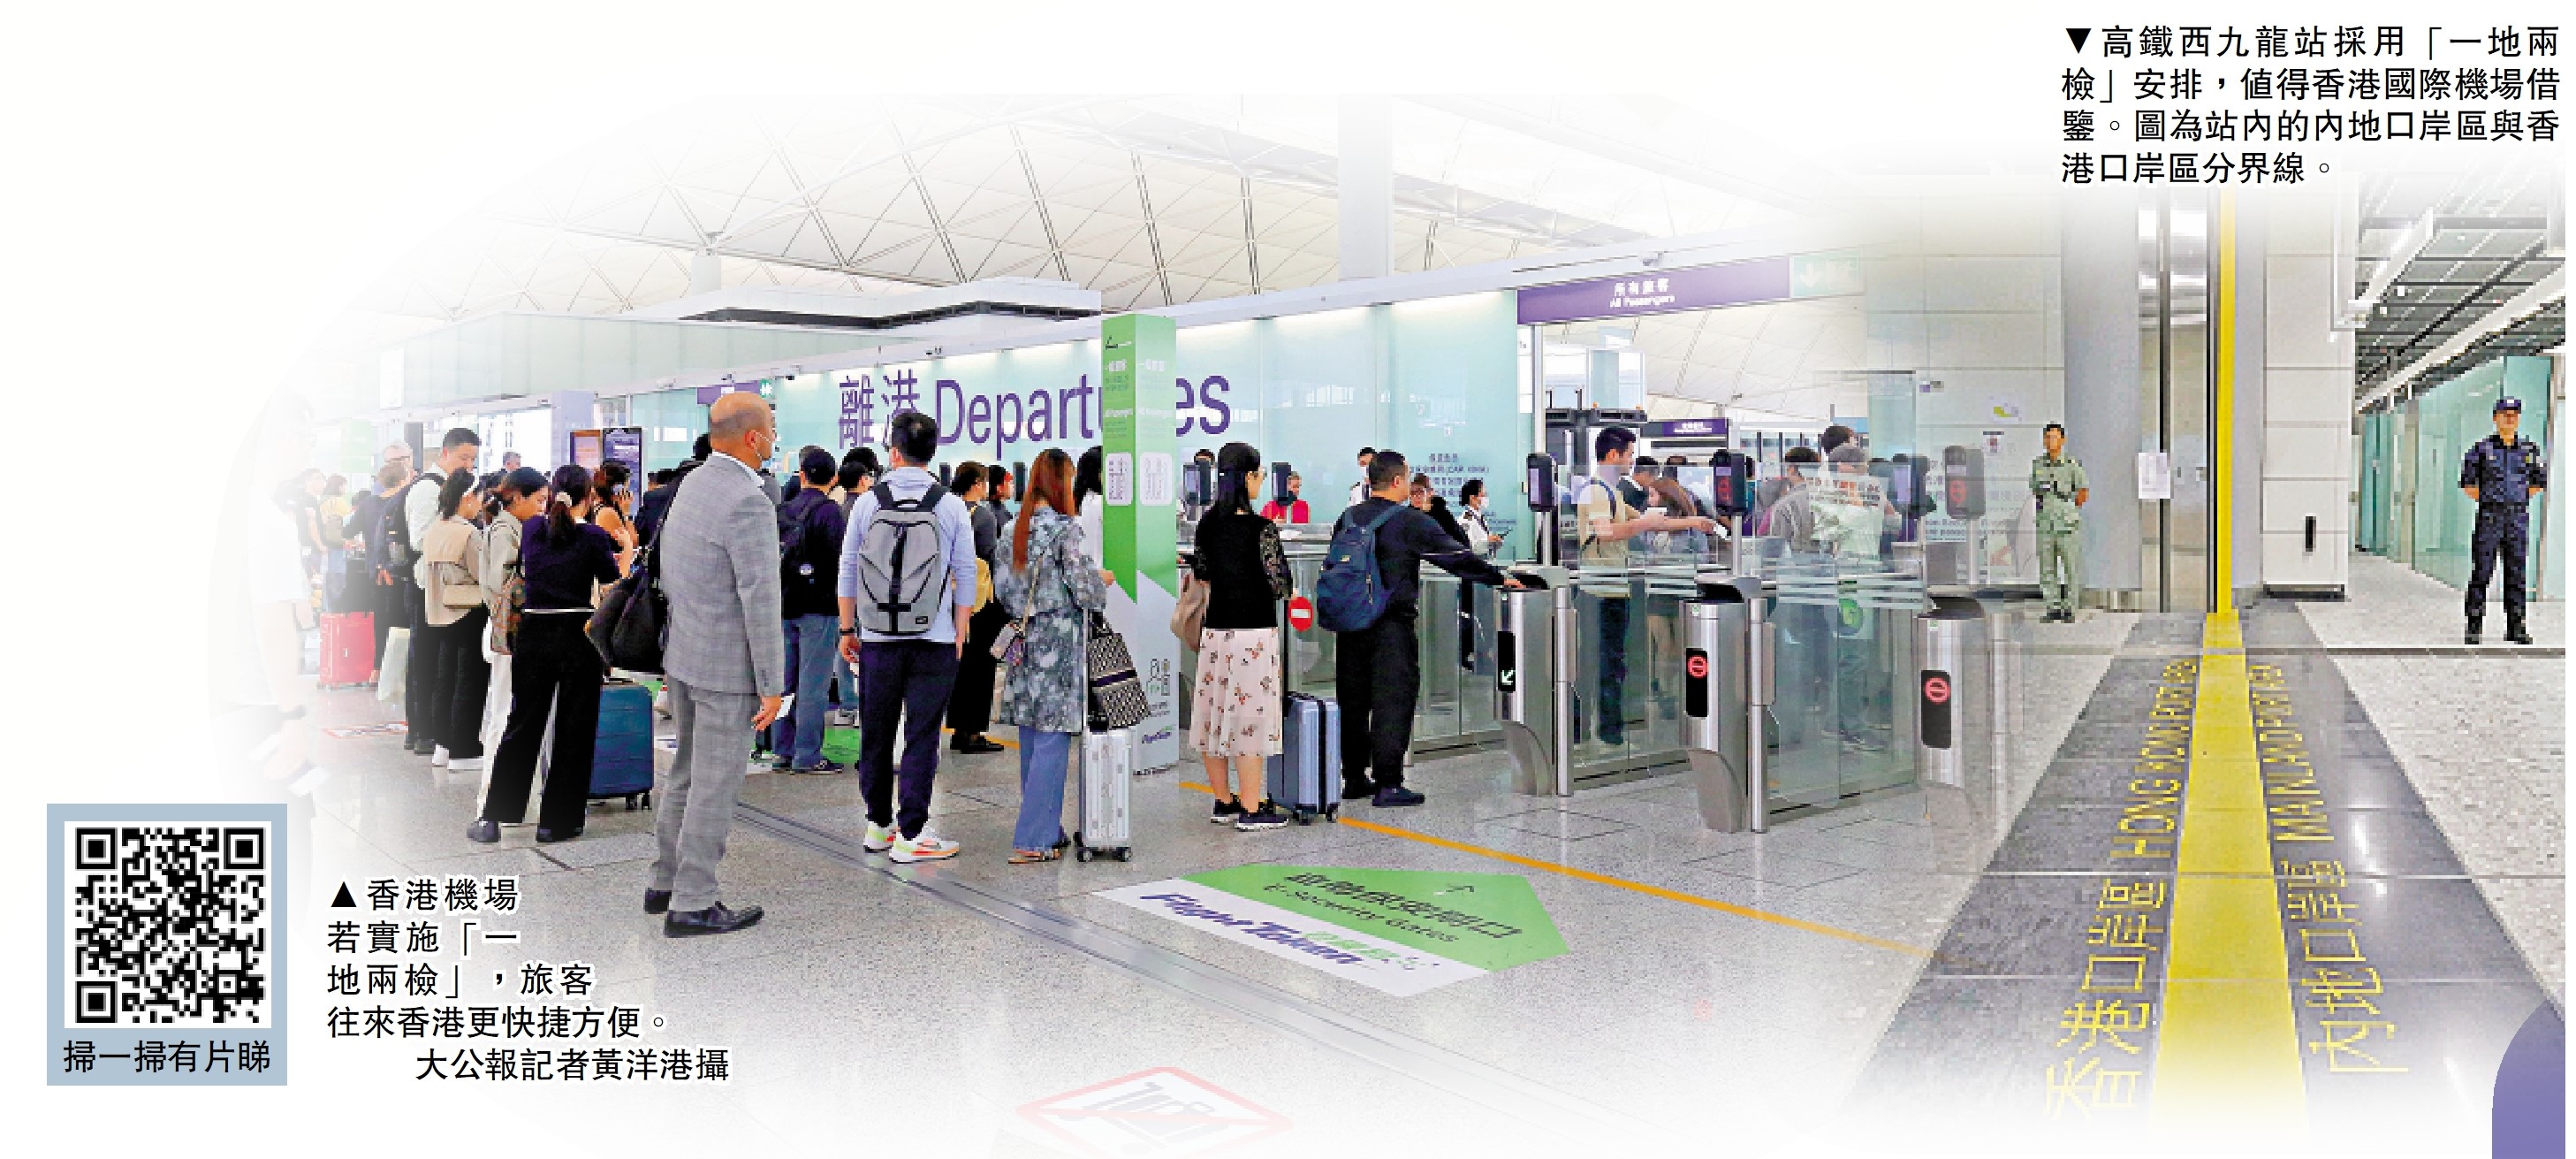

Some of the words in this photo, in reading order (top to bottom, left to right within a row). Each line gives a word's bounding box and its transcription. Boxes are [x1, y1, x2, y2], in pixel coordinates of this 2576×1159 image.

[839, 369, 920, 448] 離港
[936, 373, 1231, 461] Departes
[2044, 878, 2166, 1121] 香港口岸區
[2109, 779, 2182, 858] HONG
